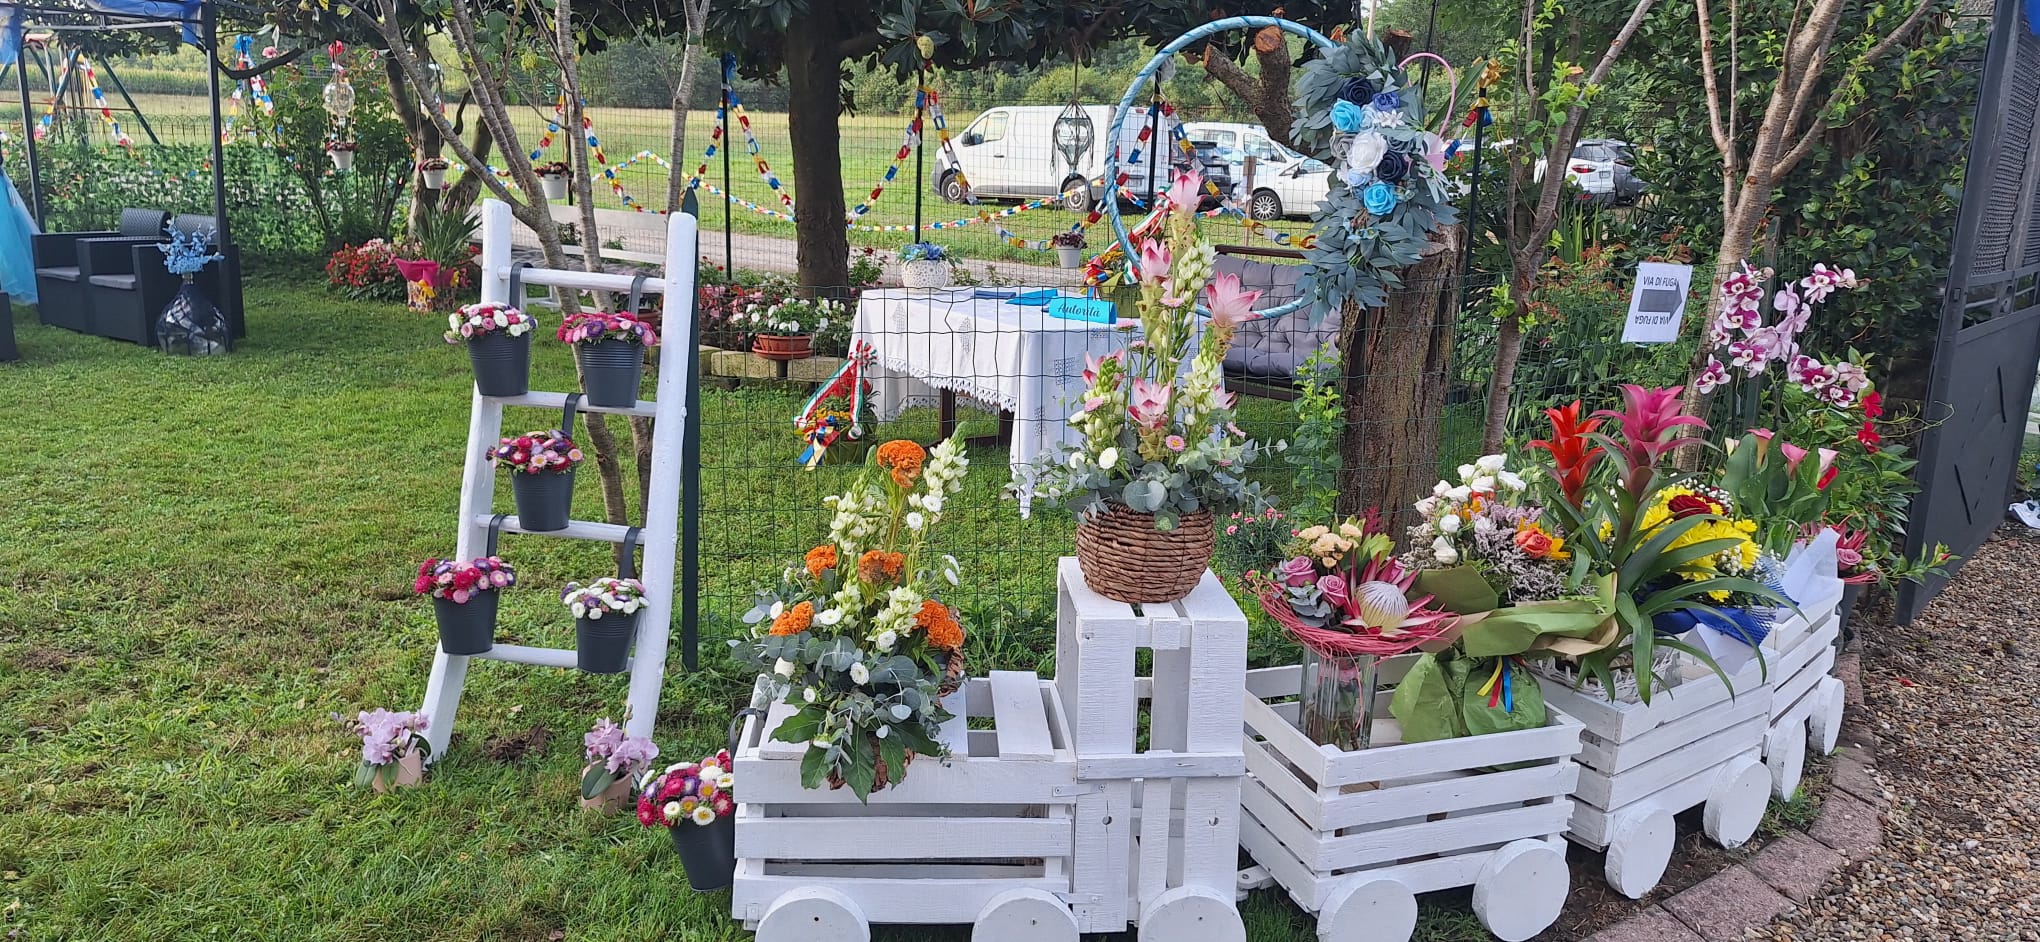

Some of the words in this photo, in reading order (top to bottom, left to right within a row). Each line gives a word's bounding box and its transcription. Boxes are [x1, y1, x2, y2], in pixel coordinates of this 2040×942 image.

[1644, 276, 1654, 286] VIA
[1655, 277, 1662, 286] DI
[1663, 277, 1678, 287] FUGA
[1635, 315, 1652, 325] FUGA
[1652, 316, 1659, 325] DI
[1660, 316, 1669, 325] VIA
